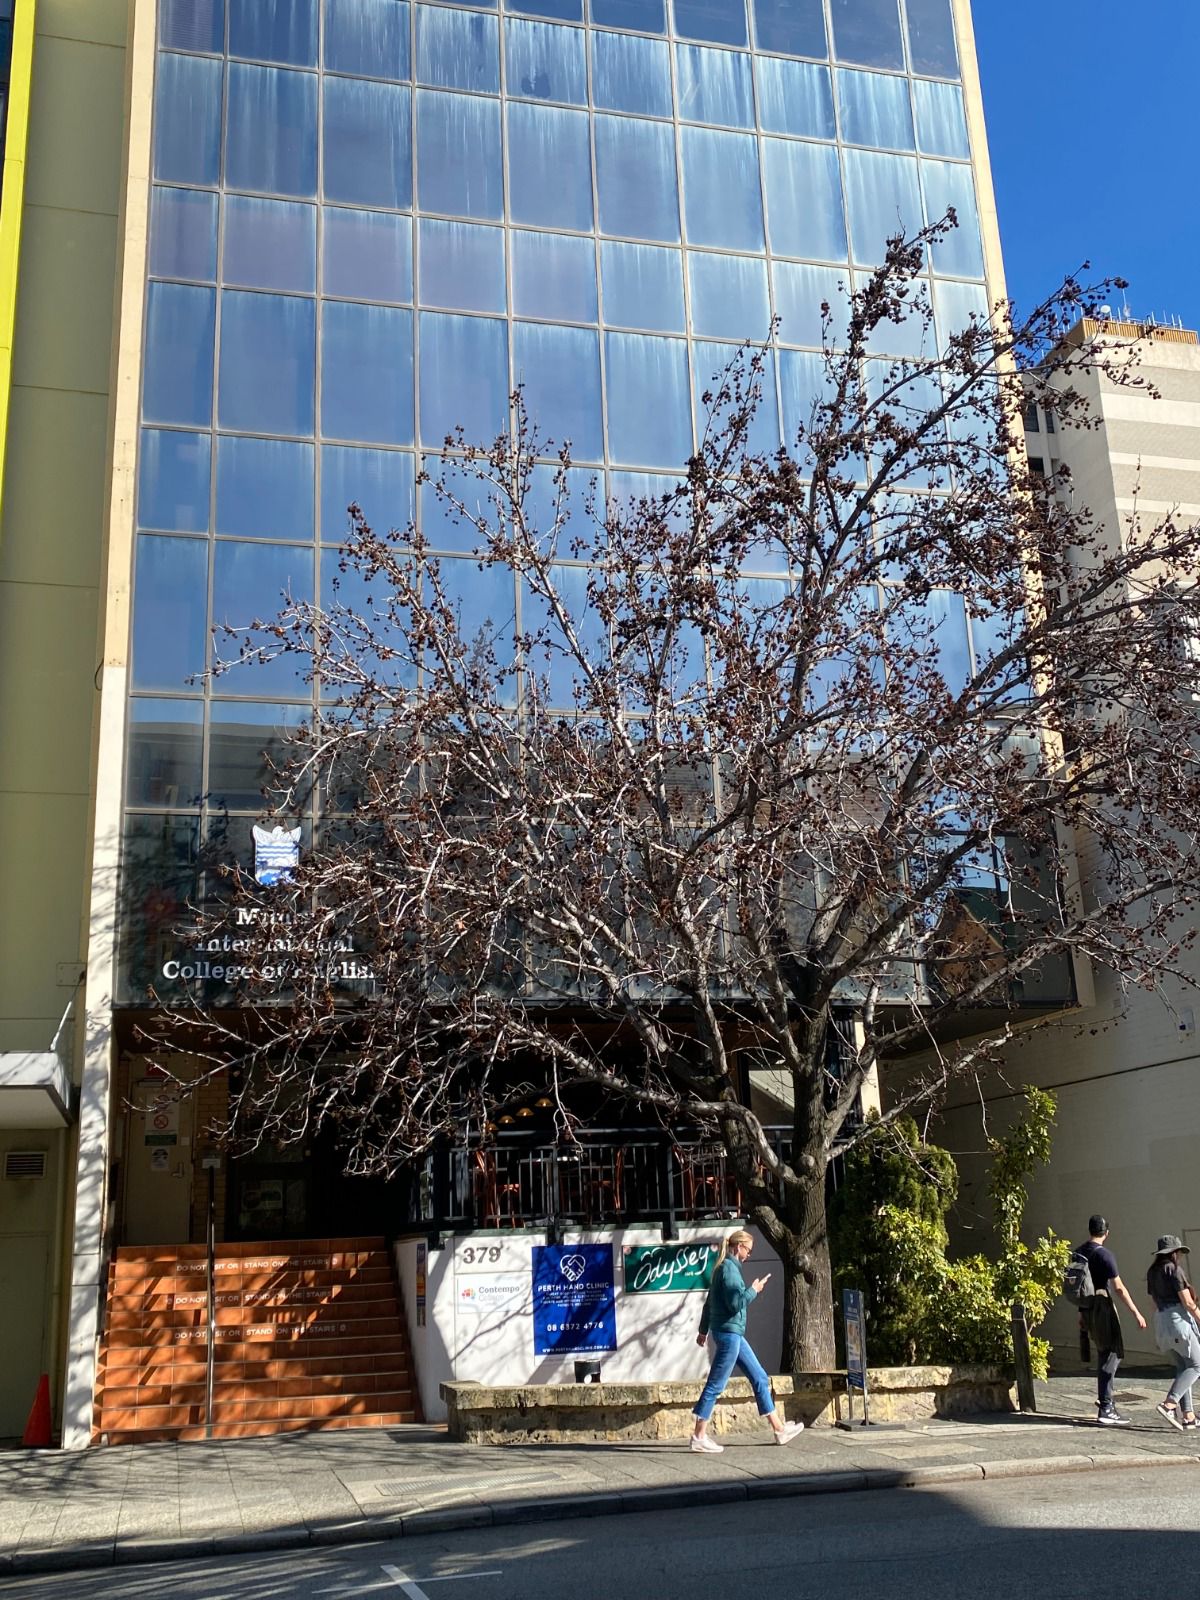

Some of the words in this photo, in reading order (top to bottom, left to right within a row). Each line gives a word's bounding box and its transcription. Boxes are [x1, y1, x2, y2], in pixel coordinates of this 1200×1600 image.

[163, 961, 254, 983] College
[463, 1246, 501, 1264] 379
[176, 1264, 189, 1272] DO
[189, 1263, 207, 1271] NOT
[226, 1262, 239, 1270] OR
[243, 1261, 269, 1269] STAND
[303, 1258, 328, 1266] STAIRS
[478, 1285, 520, 1295] Contempo
[537, 1284, 562, 1292] PERTH
[563, 1283, 585, 1291] HAND
[175, 1296, 188, 1304] DO
[189, 1295, 207, 1304] NOT
[214, 1295, 226, 1303] SIT
[227, 1294, 239, 1302] OR
[244, 1293, 271, 1302] STAND
[274, 1292, 287, 1300] ON
[175, 1331, 188, 1339] DO
[188, 1330, 206, 1338] NOT
[214, 1329, 226, 1337] SIT
[228, 1328, 241, 1337] OR
[246, 1327, 273, 1336] STAND
[276, 1326, 288, 1335] ON
[309, 1324, 336, 1333] STAIRS
[546, 1323, 558, 1332] 08
[583, 1321, 604, 1330] 4776
